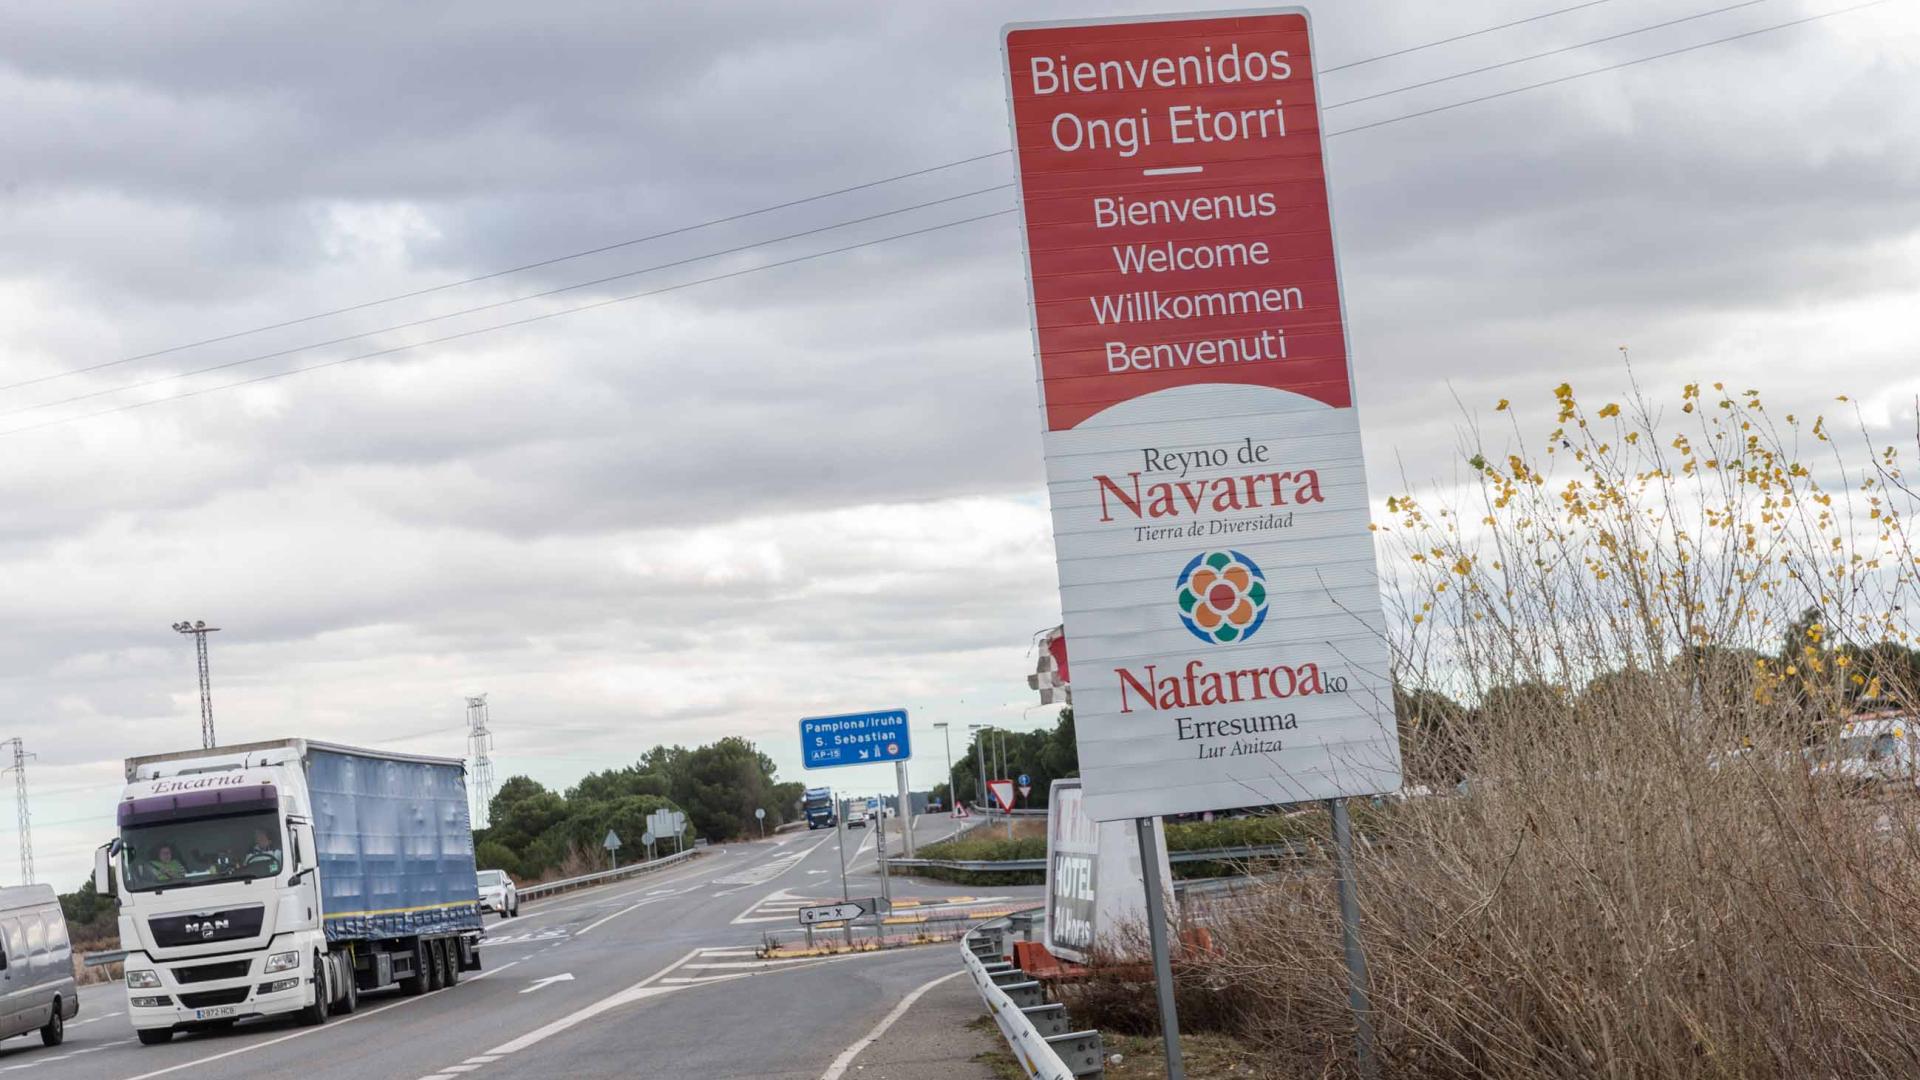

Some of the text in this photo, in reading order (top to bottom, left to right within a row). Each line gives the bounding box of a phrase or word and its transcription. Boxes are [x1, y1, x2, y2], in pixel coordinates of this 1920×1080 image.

[1030, 43, 1292, 95] Bienvenidos
[1051, 99, 1286, 157] Ongi Etorri
[1093, 192, 1276, 229] Bienvenus
[1112, 241, 1270, 275] Welcome
[1090, 286, 1304, 325] Willkommen
[1105, 329, 1287, 373] Benvenuti
[1141, 437, 1270, 478] Reyno de
[1093, 468, 1326, 522] Navarra
[1134, 512, 1293, 542] Tierra de Diversidad
[1113, 660, 1348, 713] Nafarroako
[815, 731, 896, 747] S. Sebastian
[1175, 711, 1298, 741] Erresuma
[813, 749, 840, 759] AP-15
[1199, 739, 1282, 760] Lur Anitza
[151, 774, 245, 794] Encarna
[1054, 856, 1095, 900] HOTEL
[185, 919, 230, 933] MAN
